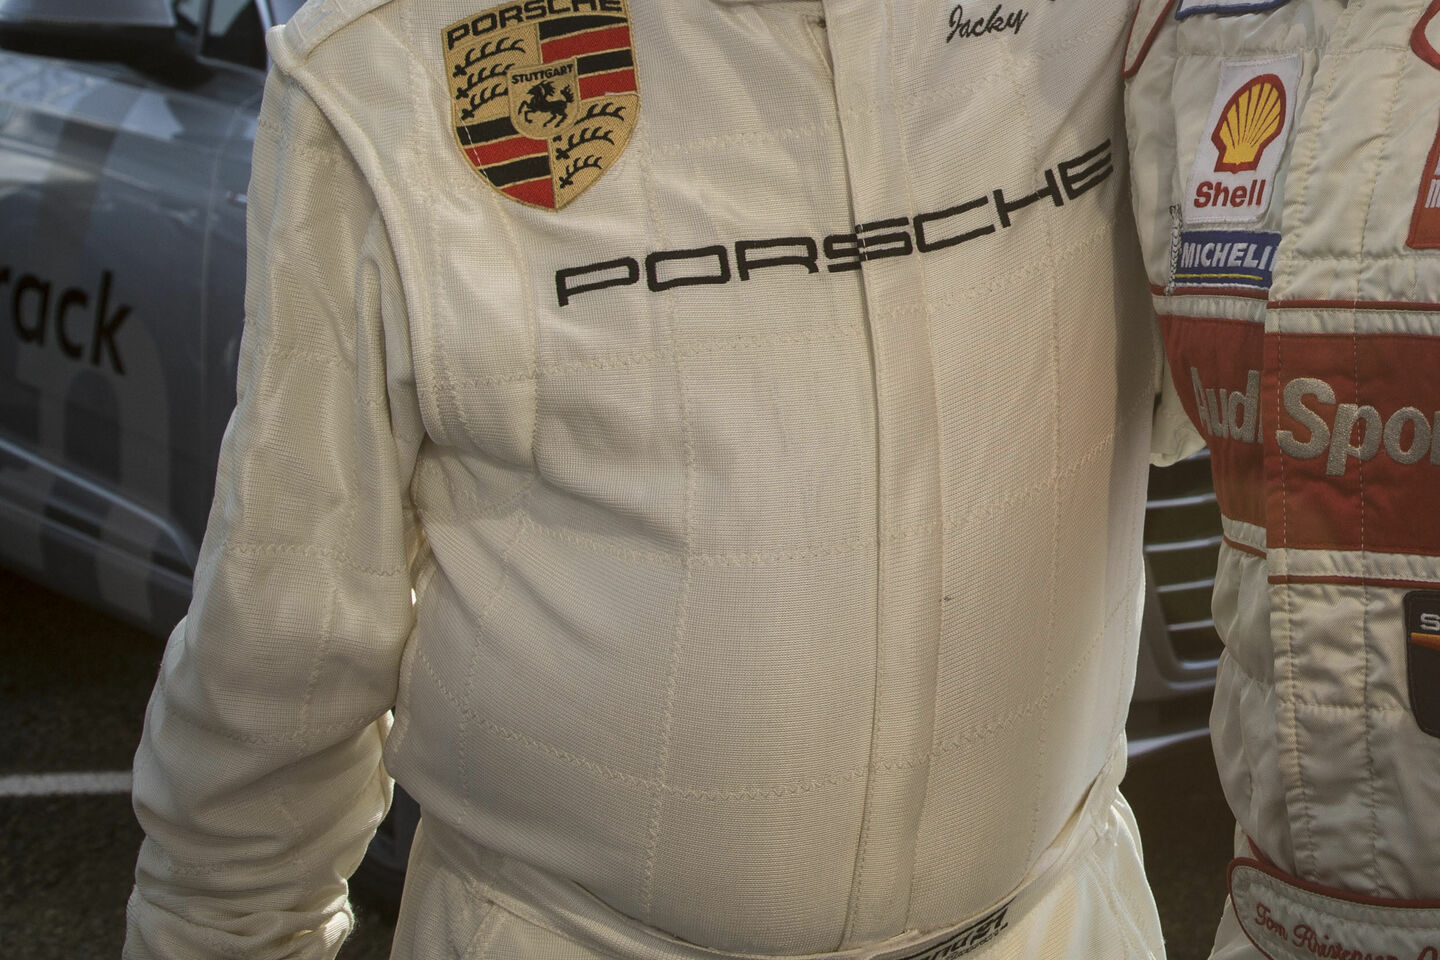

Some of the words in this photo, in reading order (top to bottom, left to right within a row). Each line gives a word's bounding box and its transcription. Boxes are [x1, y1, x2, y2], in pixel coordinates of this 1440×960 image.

[946, 3, 1028, 44] Jacky
[511, 63, 574, 85] STUTTGART
[1194, 179, 1266, 209] Shell
[556, 140, 1113, 306] PORSCHE
[1190, 366, 1263, 444] Aud
[1255, 902, 1289, 940] Tom
